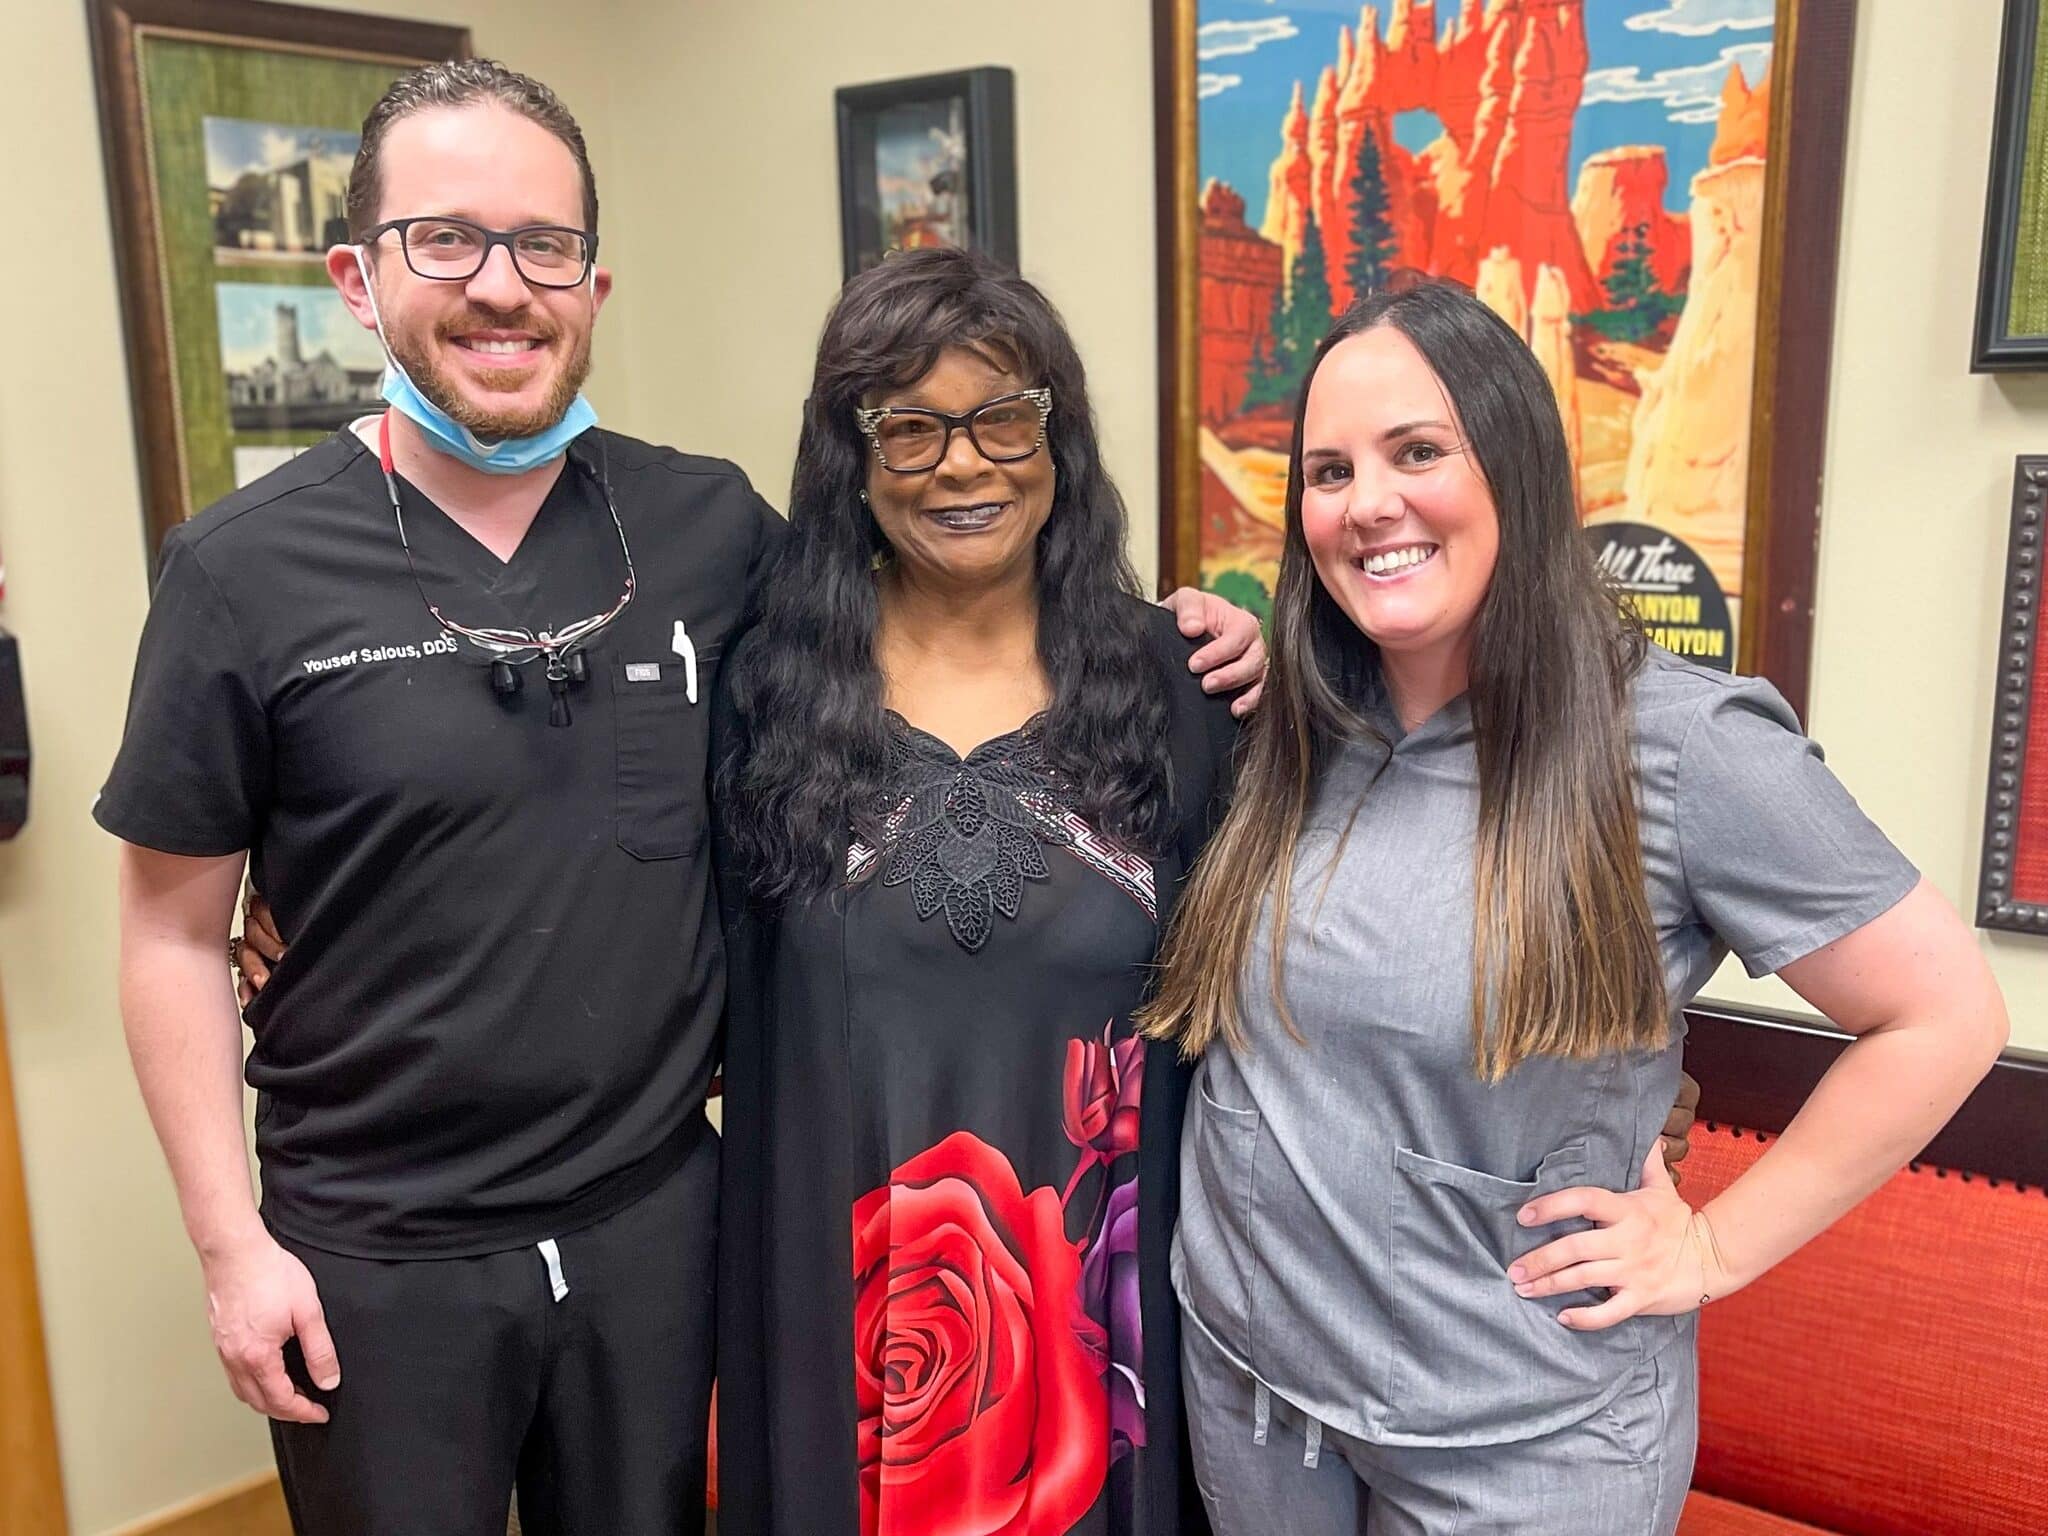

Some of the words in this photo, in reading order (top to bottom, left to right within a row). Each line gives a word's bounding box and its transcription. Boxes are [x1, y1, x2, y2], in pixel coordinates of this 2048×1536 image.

[1595, 540, 1636, 580] All
[1632, 537, 1695, 583] Three
[303, 650, 357, 674] Yousef
[361, 645, 422, 662] Salous,
[423, 637, 458, 656] DDS
